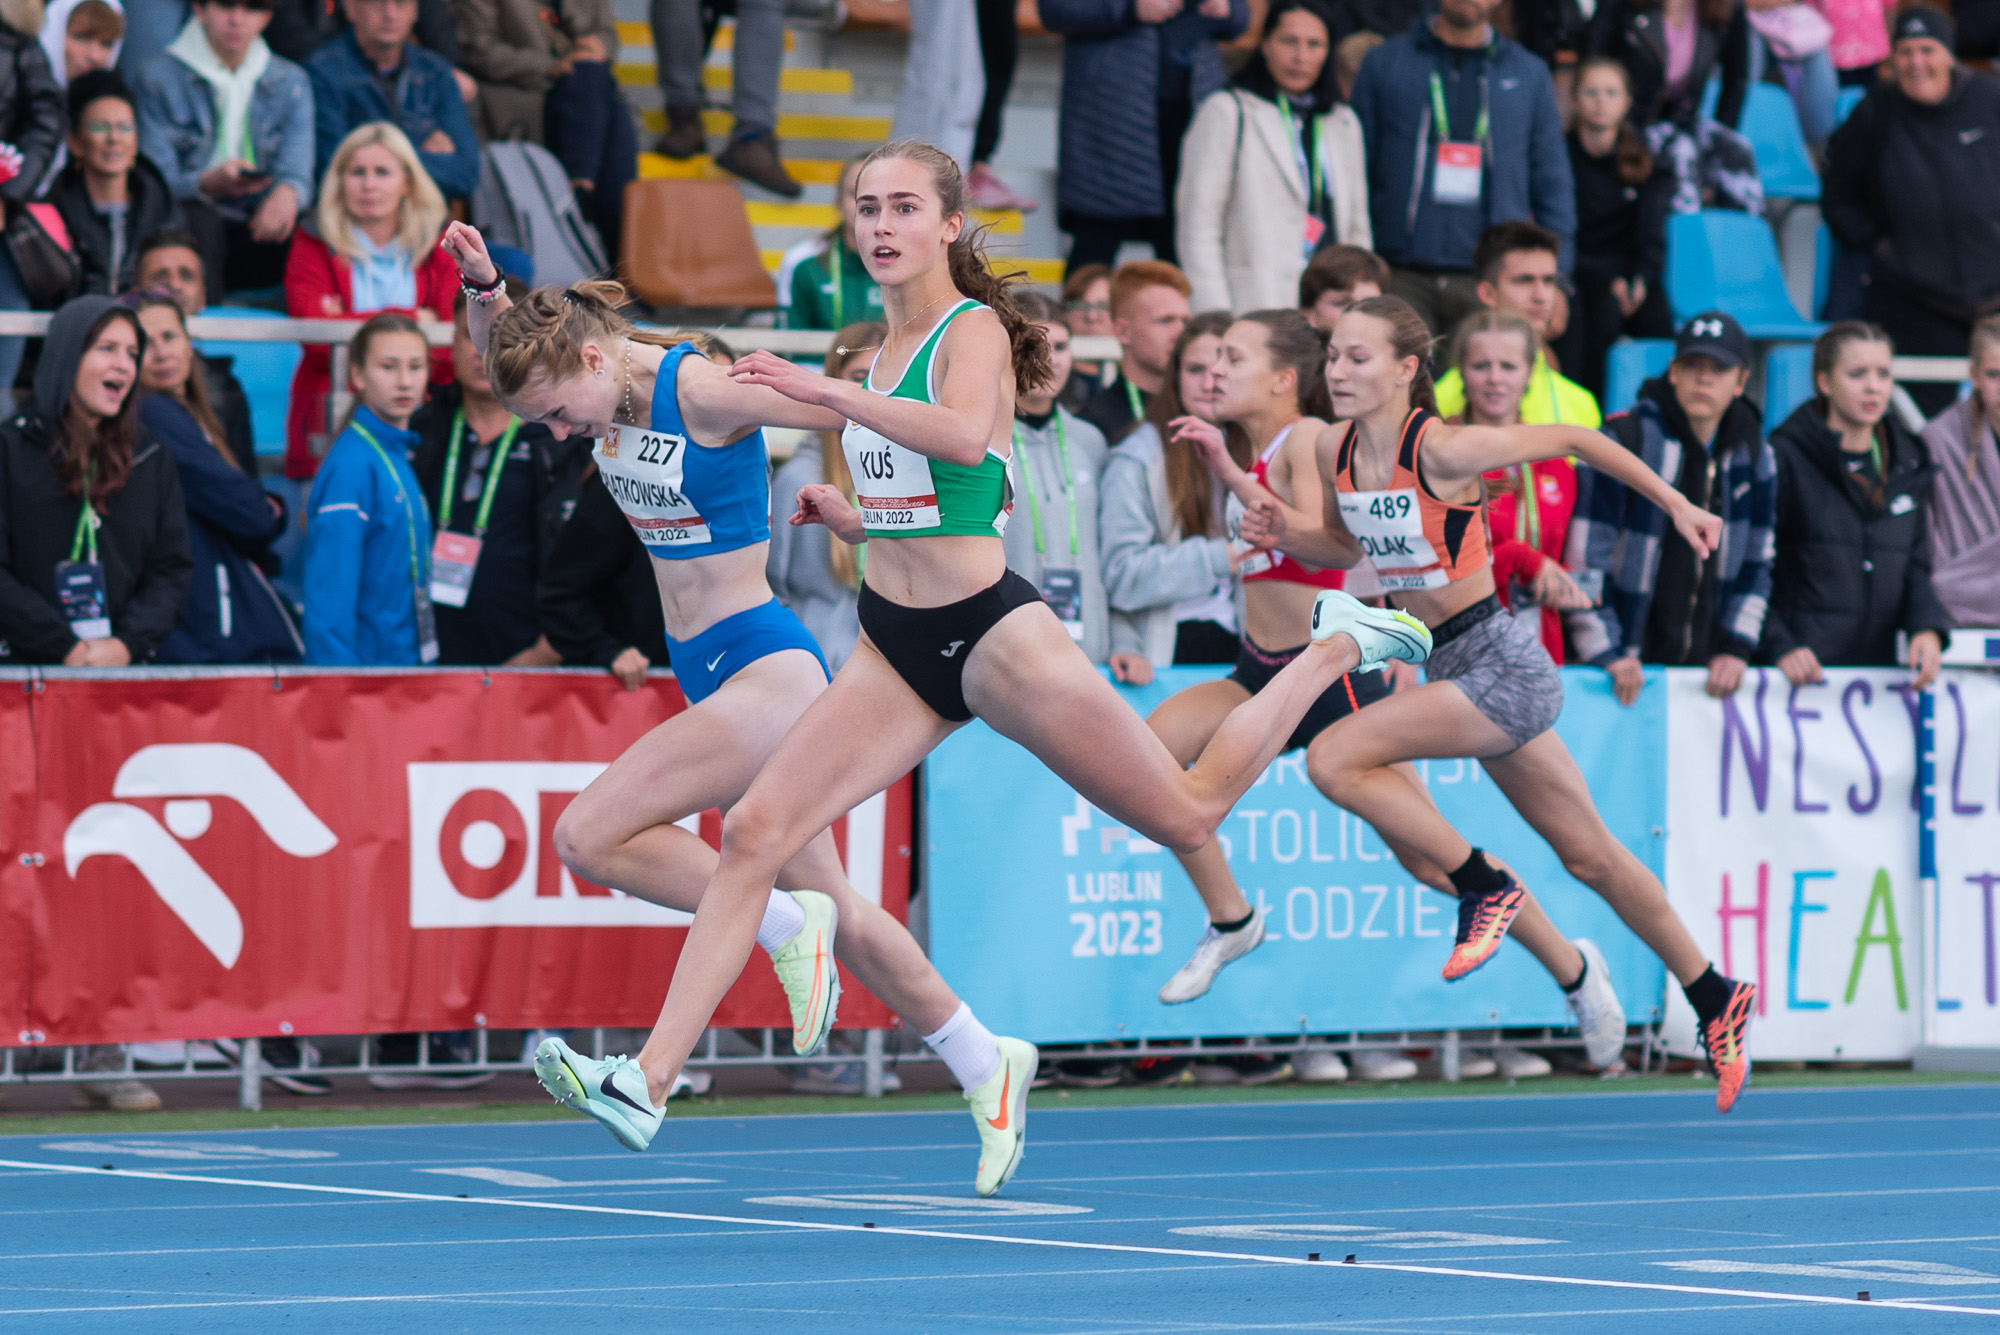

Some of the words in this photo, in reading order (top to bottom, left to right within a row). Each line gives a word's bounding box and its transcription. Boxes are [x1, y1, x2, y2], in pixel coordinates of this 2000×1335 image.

[637, 434, 679, 466] 227
[859, 445, 895, 480] KUŚ
[886, 510, 915, 524] 2022
[1369, 495, 1412, 520] 489
[657, 528, 691, 541] 2022
[1359, 536, 1415, 556] OLAK
[1400, 576, 1426, 588] 2022
[1719, 668, 2000, 820] NESTL
[1217, 808, 1394, 864] TOLIC
[1066, 871, 1163, 903] LUBLIN
[1206, 884, 1458, 942] ŁODZIE
[1069, 910, 1164, 958] 2023
